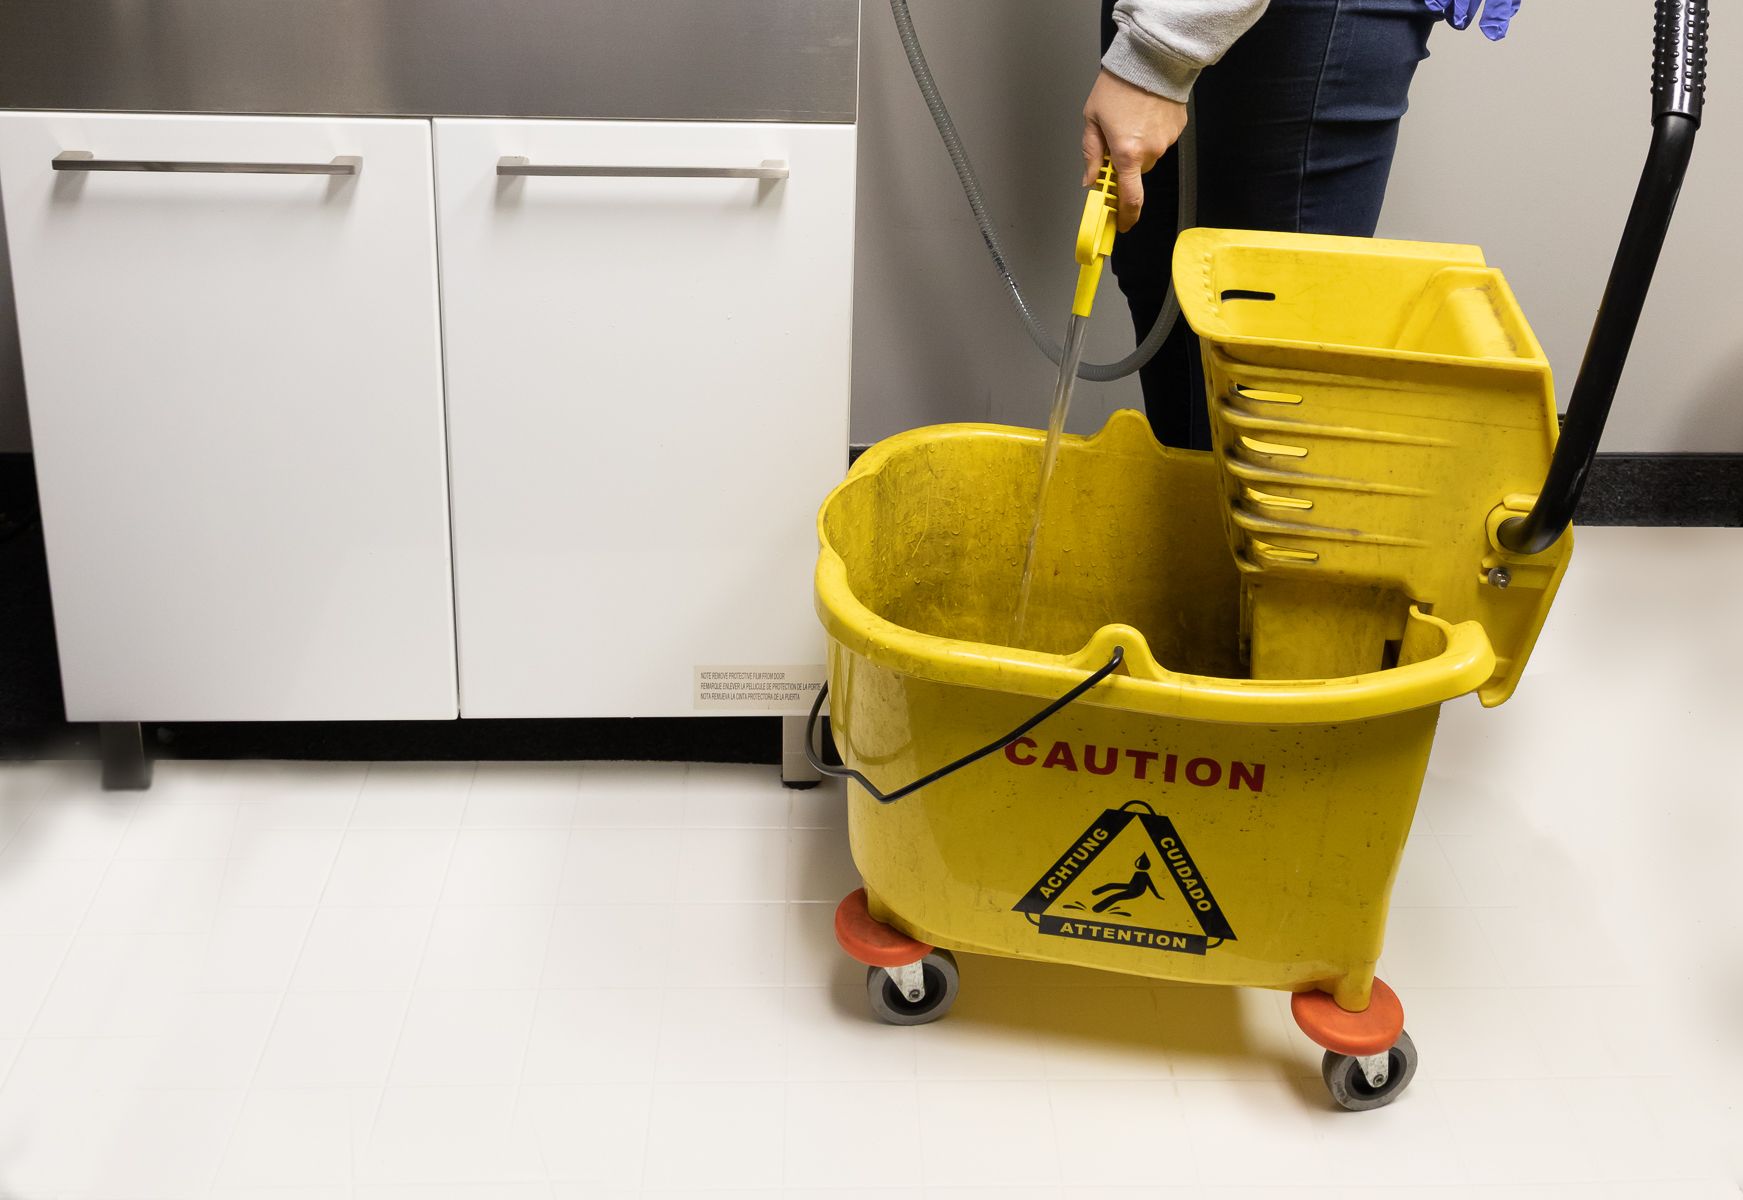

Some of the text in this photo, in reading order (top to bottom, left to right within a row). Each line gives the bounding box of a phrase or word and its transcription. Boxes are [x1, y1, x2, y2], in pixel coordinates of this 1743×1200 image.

[1004, 736, 1266, 793] CAUTION
[1038, 827, 1109, 899] ACHTUNG
[1160, 836, 1212, 912] CUIDADO
[1060, 922, 1187, 949] ATTENTION
